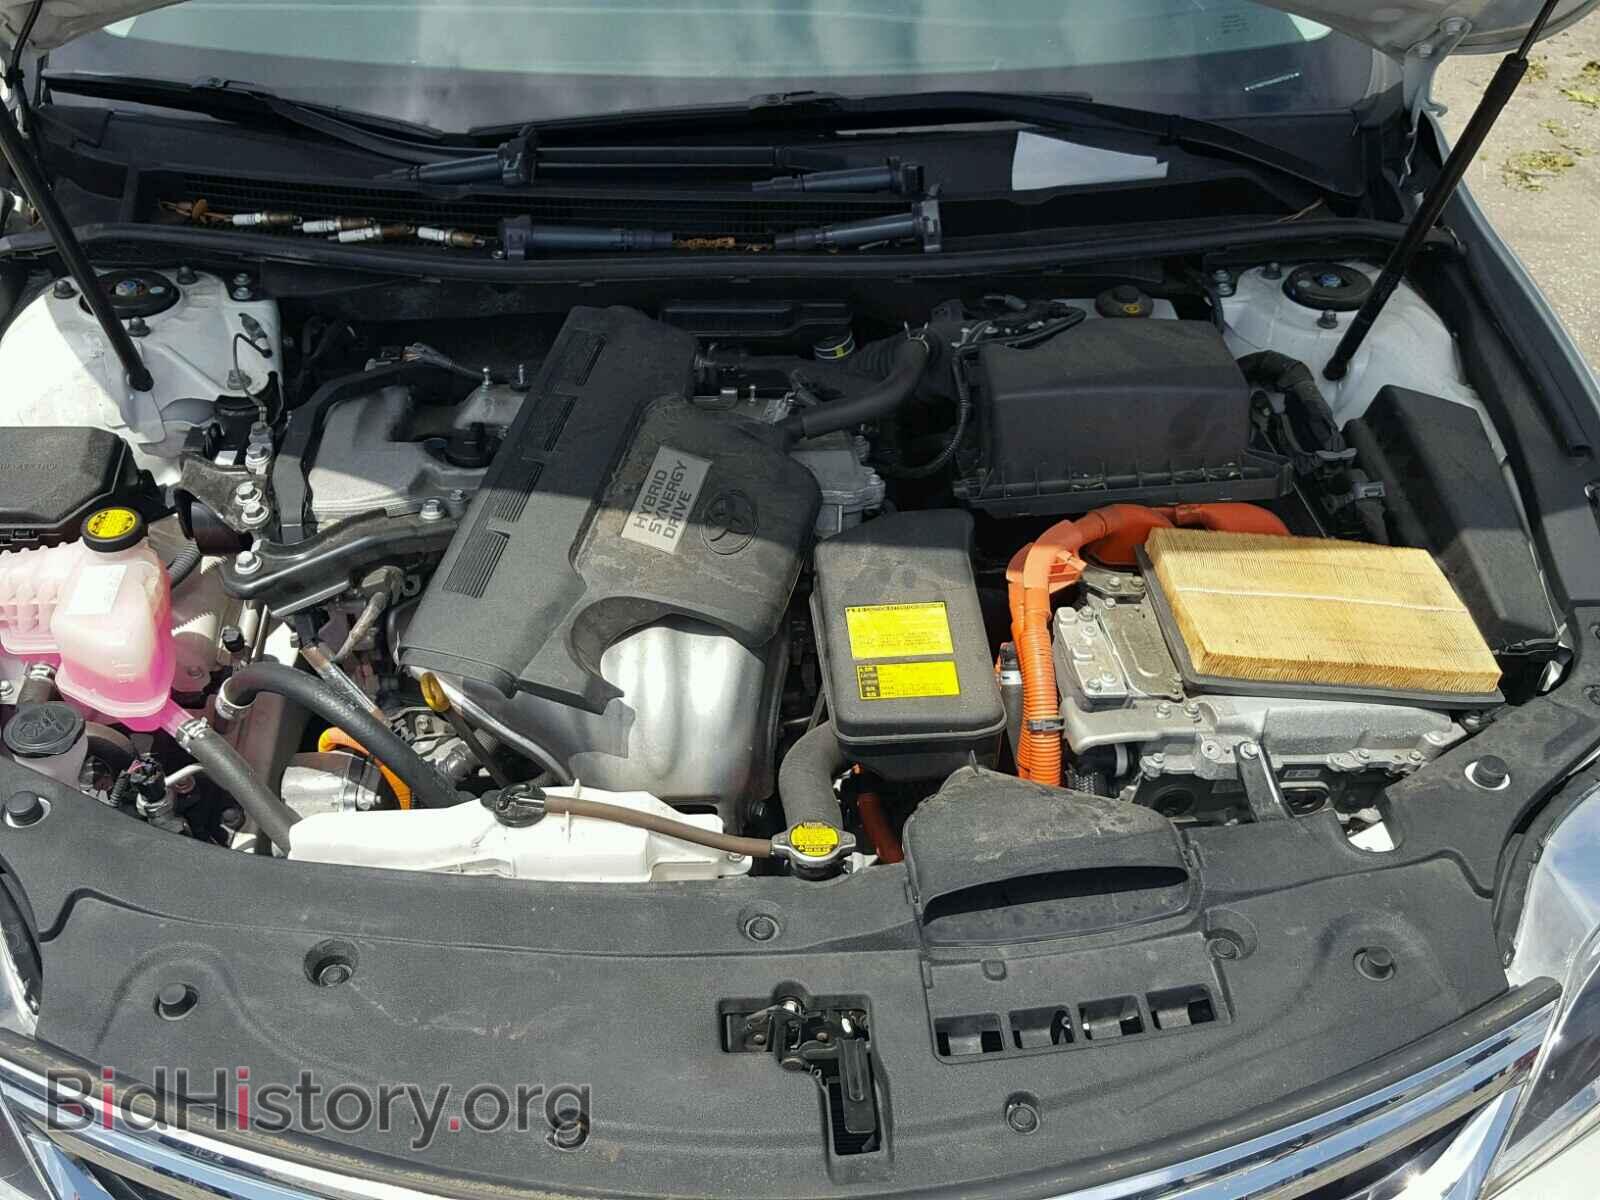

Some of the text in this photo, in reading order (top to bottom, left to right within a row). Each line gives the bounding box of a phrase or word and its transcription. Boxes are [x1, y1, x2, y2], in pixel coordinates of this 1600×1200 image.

[633, 469, 668, 530] HYBRID
[648, 459, 688, 535] SYNERGY
[662, 490, 693, 540] DRIVE
